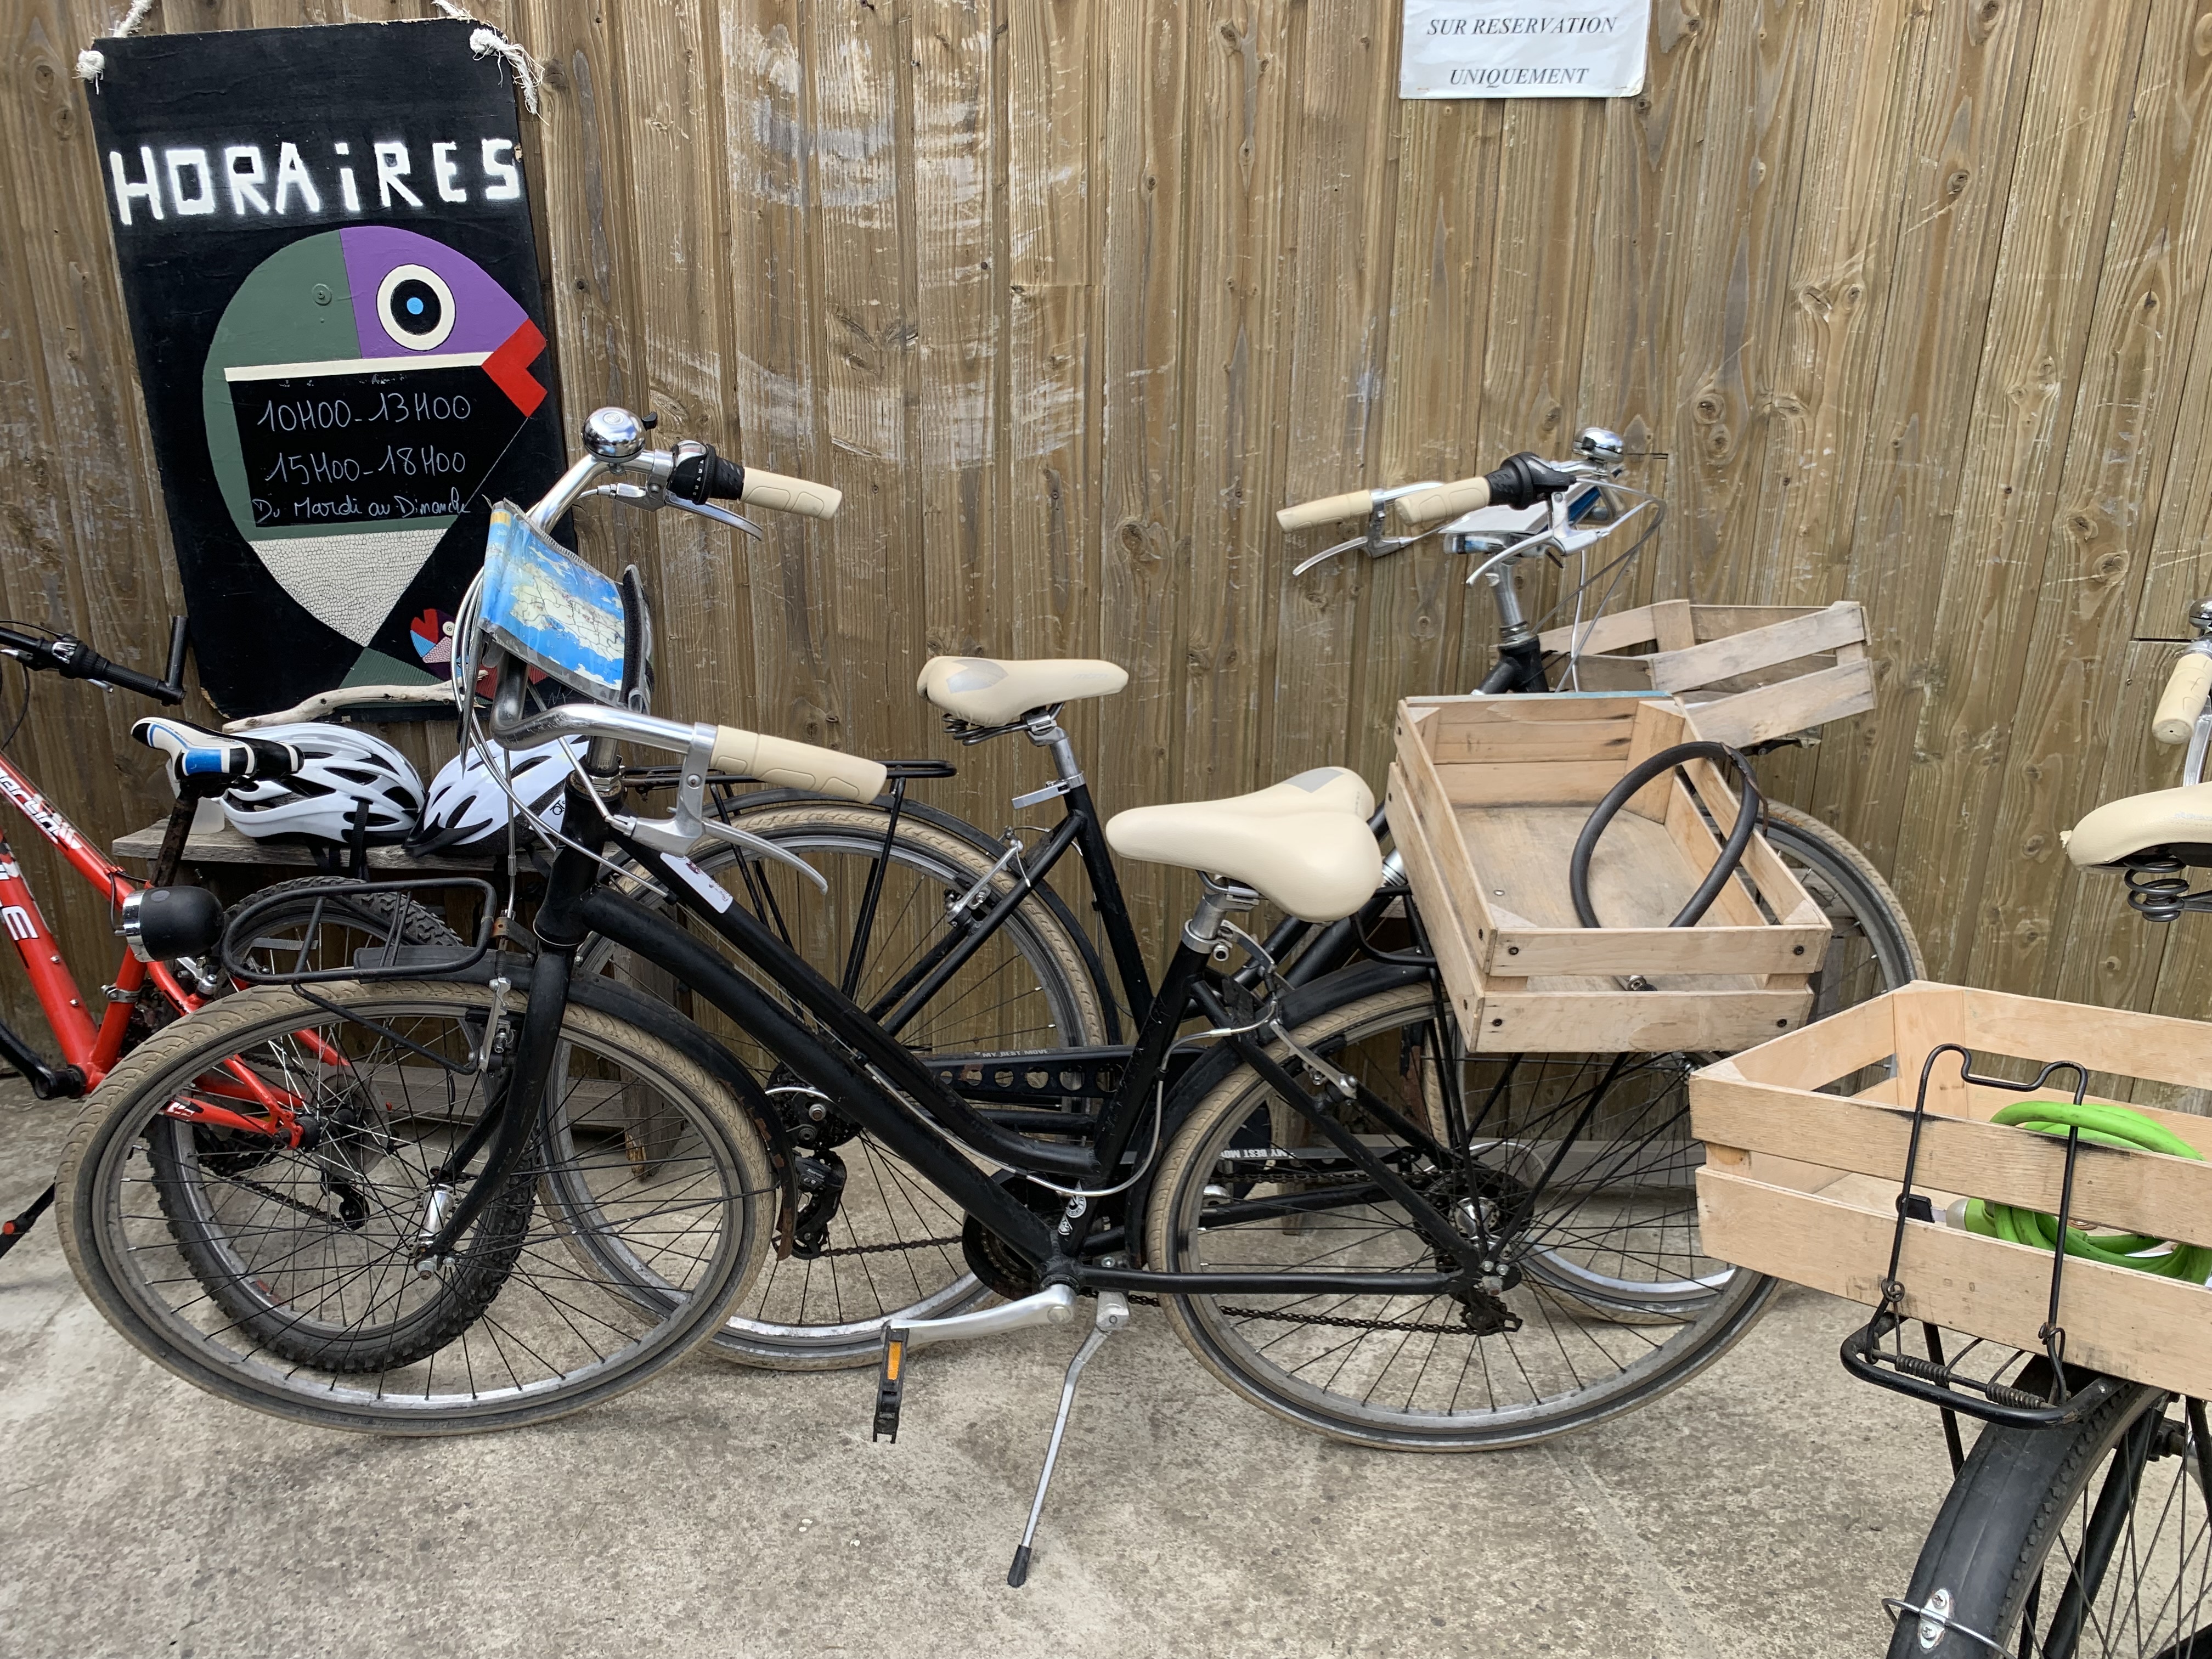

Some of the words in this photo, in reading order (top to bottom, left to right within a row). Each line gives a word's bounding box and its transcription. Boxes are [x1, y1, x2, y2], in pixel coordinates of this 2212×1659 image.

[1426, 18, 1466, 35] SUR
[1471, 17, 1618, 35] RESERVATION
[1449, 68, 1589, 88] UNIQUEMENT
[294, 495, 363, 518] Mardi
[394, 487, 471, 518] Dimanche
